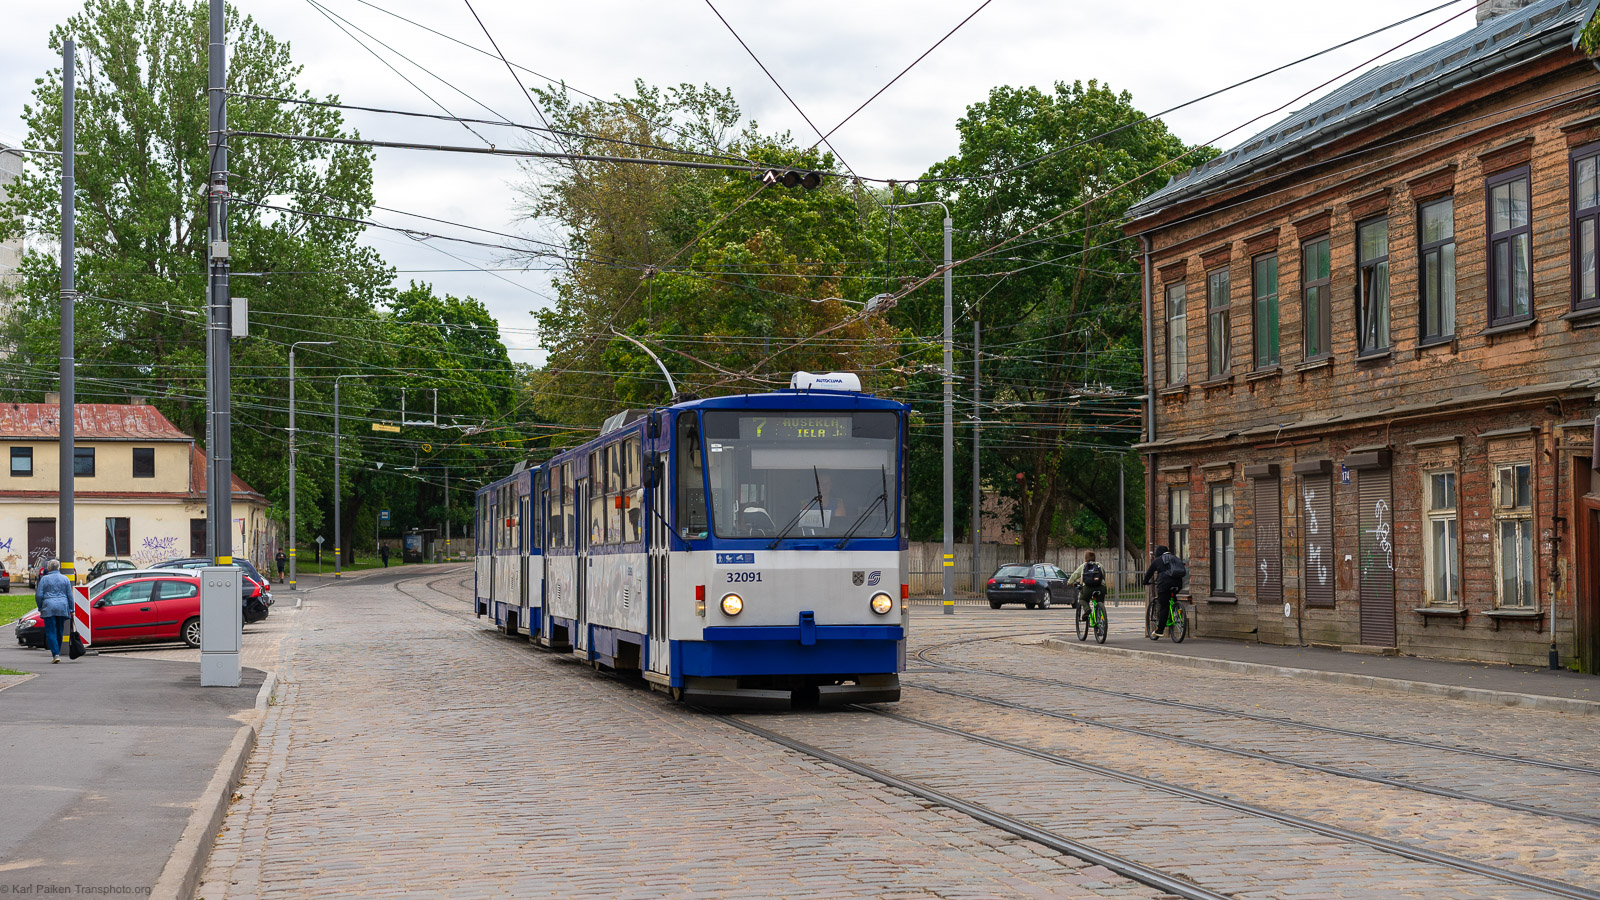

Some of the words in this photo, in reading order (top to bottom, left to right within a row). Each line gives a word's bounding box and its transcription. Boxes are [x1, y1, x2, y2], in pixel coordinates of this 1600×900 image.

[752, 417, 767, 438] 7
[797, 429, 826, 437] IELA
[726, 571, 763, 583] 32091
